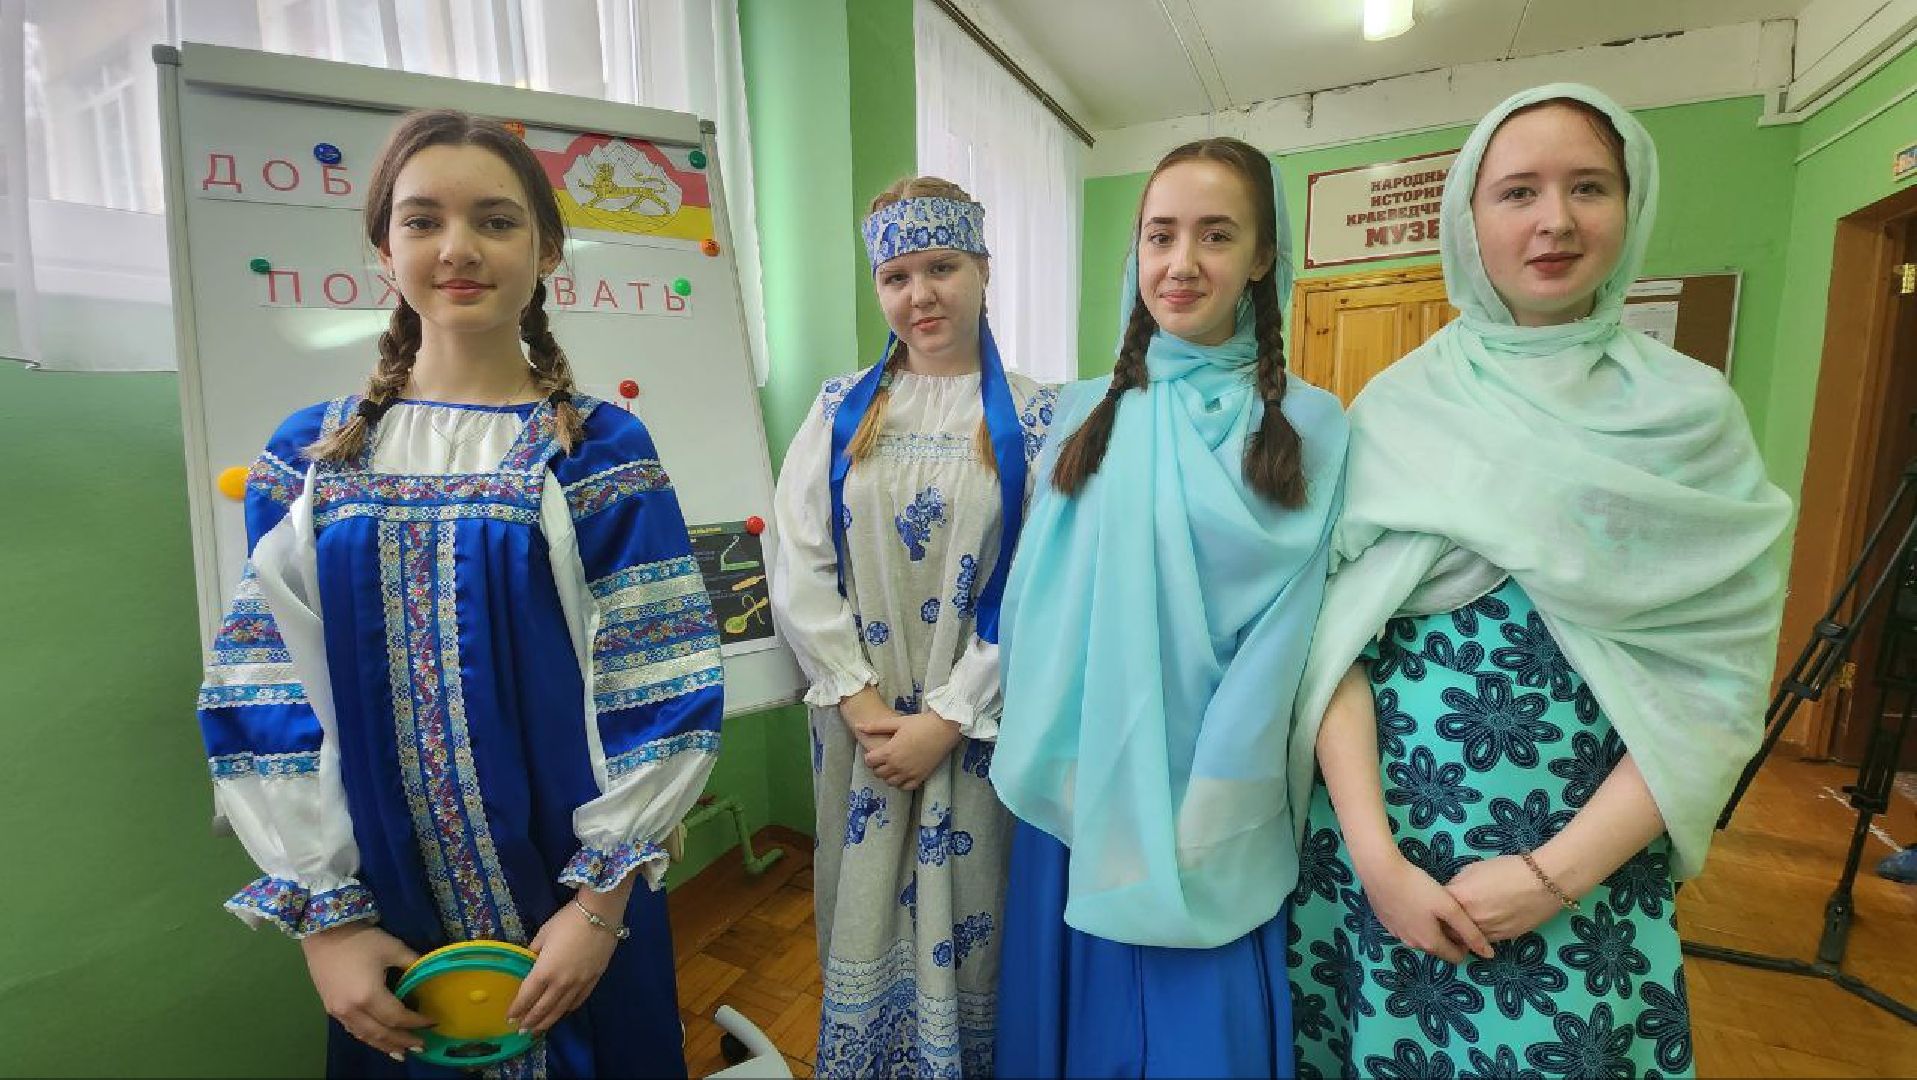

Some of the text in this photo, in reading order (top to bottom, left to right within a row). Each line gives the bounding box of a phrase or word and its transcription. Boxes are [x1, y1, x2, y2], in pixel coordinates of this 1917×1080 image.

[203, 154, 352, 195] ДОБ
[1370, 169, 1448, 191] НАРОДНЫ
[1346, 201, 1442, 226] КРАЕВЕДЧЕ
[1365, 218, 1440, 247] МУЗЕ
